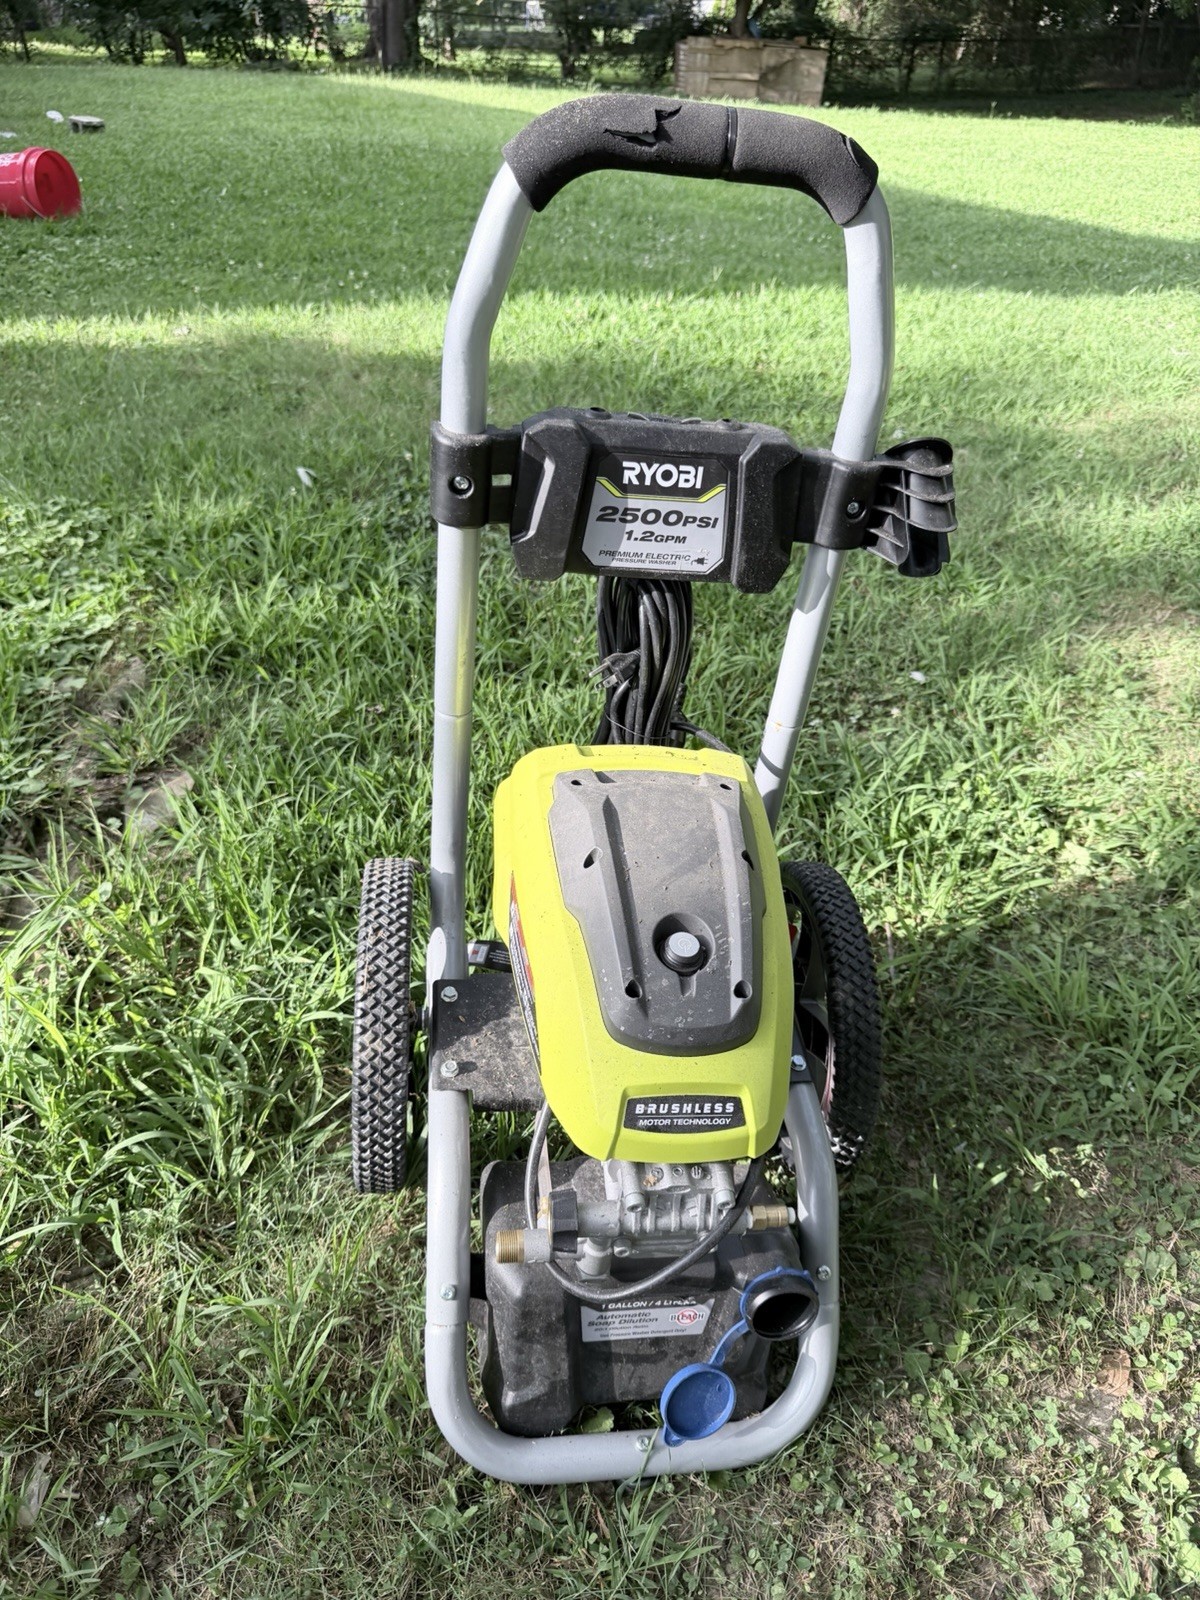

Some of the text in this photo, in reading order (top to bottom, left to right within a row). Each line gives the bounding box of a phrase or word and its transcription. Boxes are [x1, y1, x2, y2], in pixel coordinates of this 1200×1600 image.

[622, 461, 704, 489] RYOBI
[595, 505, 719, 529] 2500PSI
[624, 529, 687, 545] 1.2GPM
[598, 549, 692, 562] PREMIUM ELECTRIC
[611, 557, 647, 565] PRESSURE
[635, 1102, 735, 1114] BRUSHLESS
[638, 1117, 732, 1126] MOTOR TECHNOLOGY
[608, 1300, 648, 1309] GALLON
[596, 1312, 651, 1320] Automatic
[670, 1312, 705, 1321] BLEACH
[587, 1317, 659, 1327] Soap Dilution
